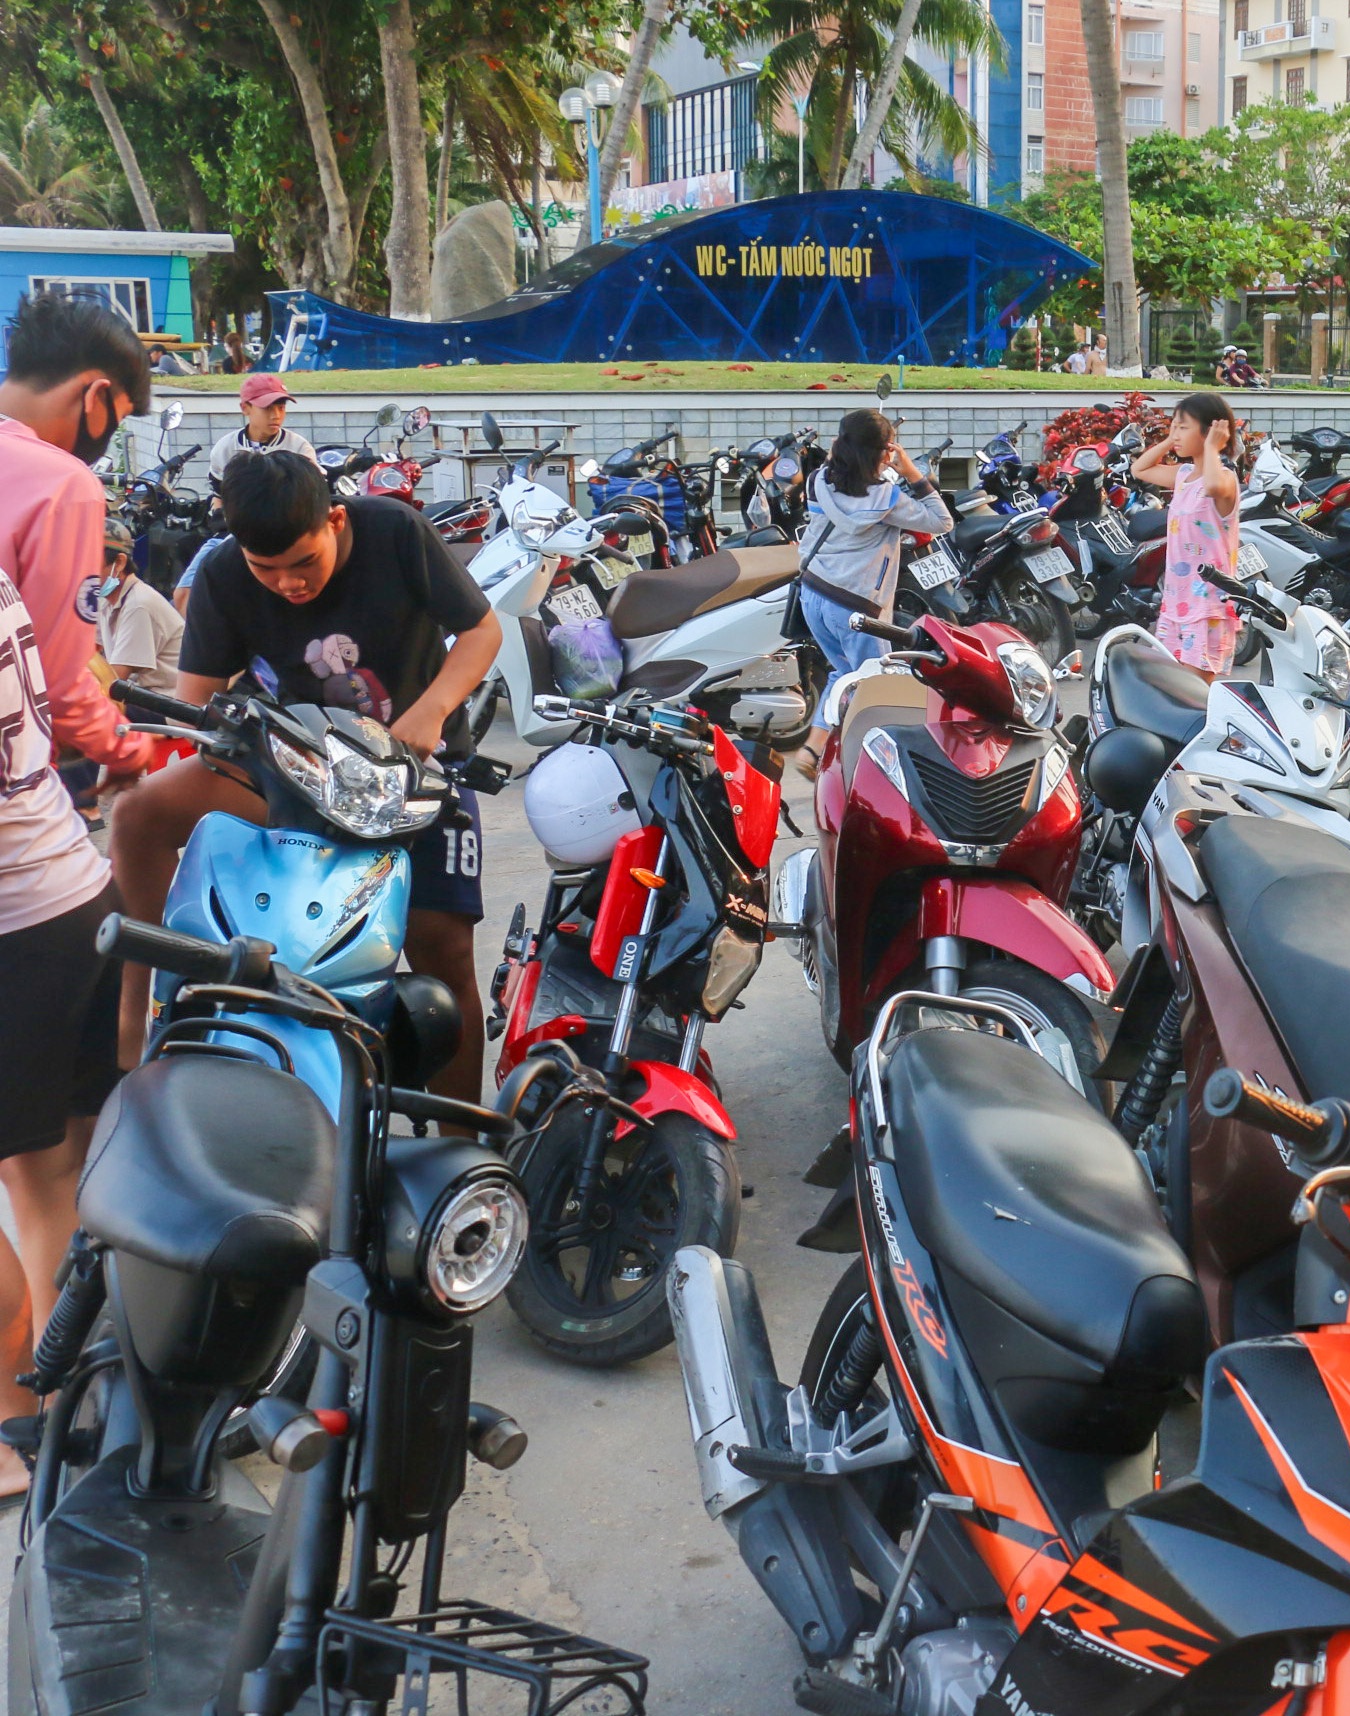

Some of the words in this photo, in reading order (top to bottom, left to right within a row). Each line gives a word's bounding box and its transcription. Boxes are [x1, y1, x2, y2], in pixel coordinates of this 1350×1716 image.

[738, 236, 777, 277] TẮM
[781, 235, 826, 276] NƯỚC
[829, 246, 873, 284] NGỌT
[915, 555, 945, 575] 79-N2
[555, 589, 588, 610] 79-N2
[277, 837, 326, 852] HONDA
[442, 827, 479, 877] 18
[618, 941, 638, 979] ONE
[868, 1165, 906, 1266] SIRIUS
